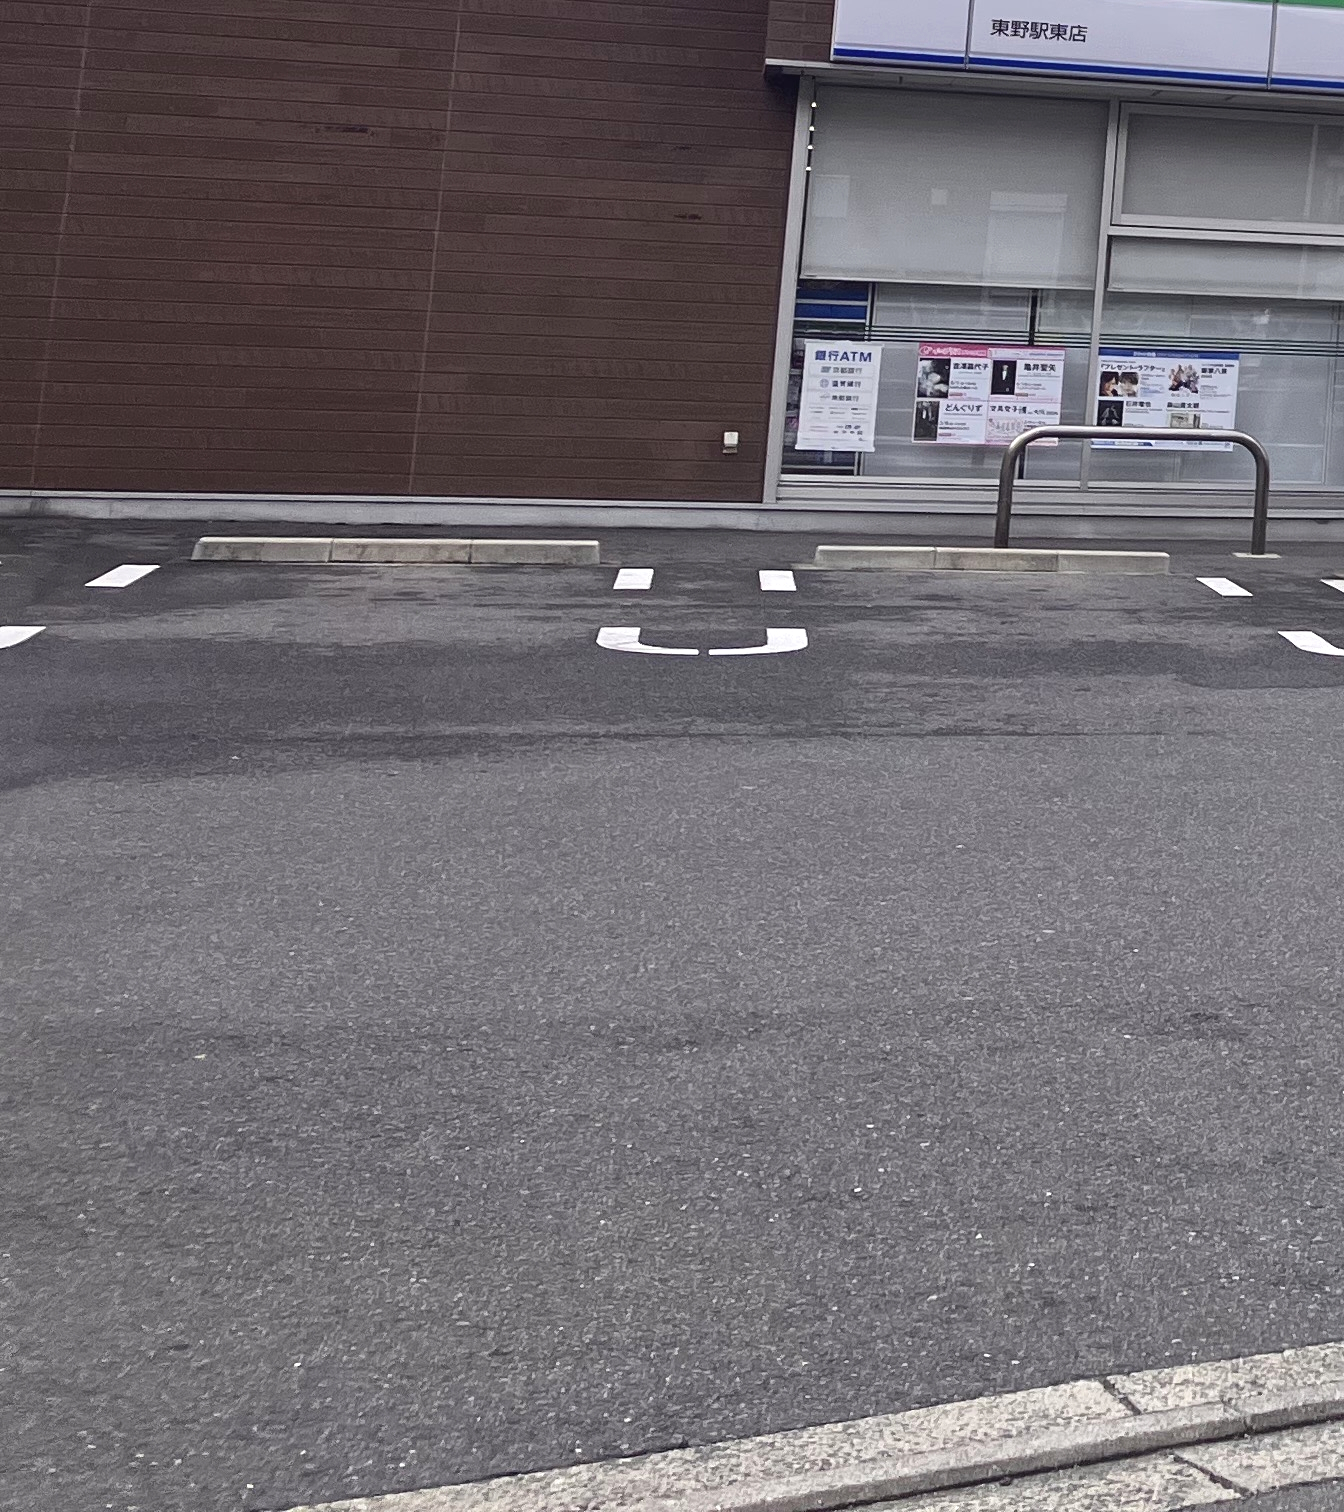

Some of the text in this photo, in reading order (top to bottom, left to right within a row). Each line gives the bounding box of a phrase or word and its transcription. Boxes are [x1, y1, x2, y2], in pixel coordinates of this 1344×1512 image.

[990, 18, 1088, 43] 東野駅東店
[815, 350, 873, 362] 銀行ATM
